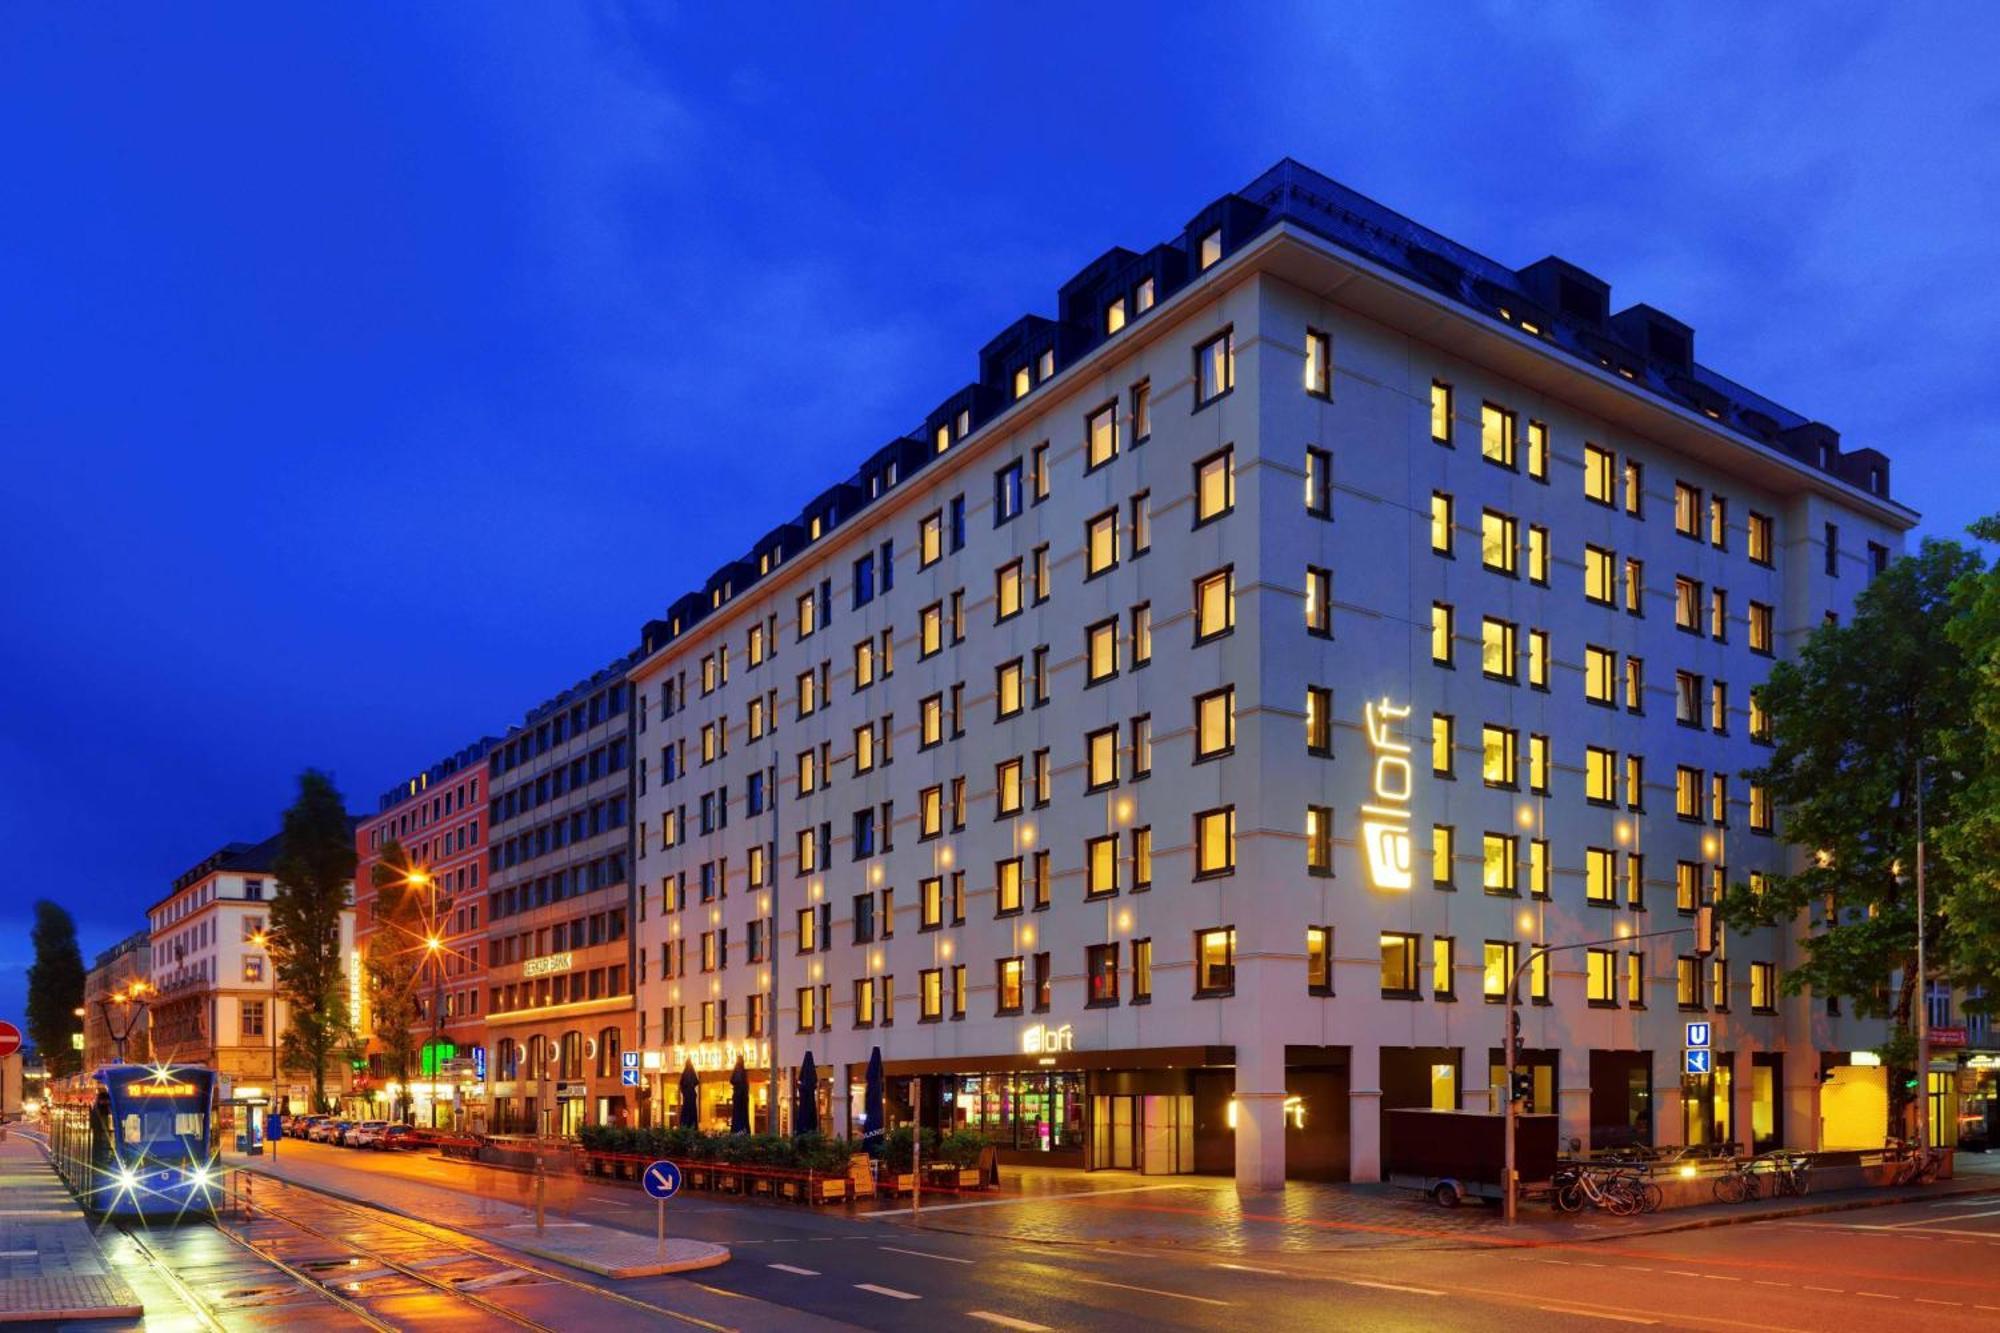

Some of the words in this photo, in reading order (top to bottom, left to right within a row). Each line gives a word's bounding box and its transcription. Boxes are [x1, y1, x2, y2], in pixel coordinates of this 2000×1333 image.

[1361, 697, 1412, 889] aloft
[1024, 1024, 1073, 1053] aloft
[1691, 1026, 1705, 1045] U
[625, 1053, 636, 1066] U
